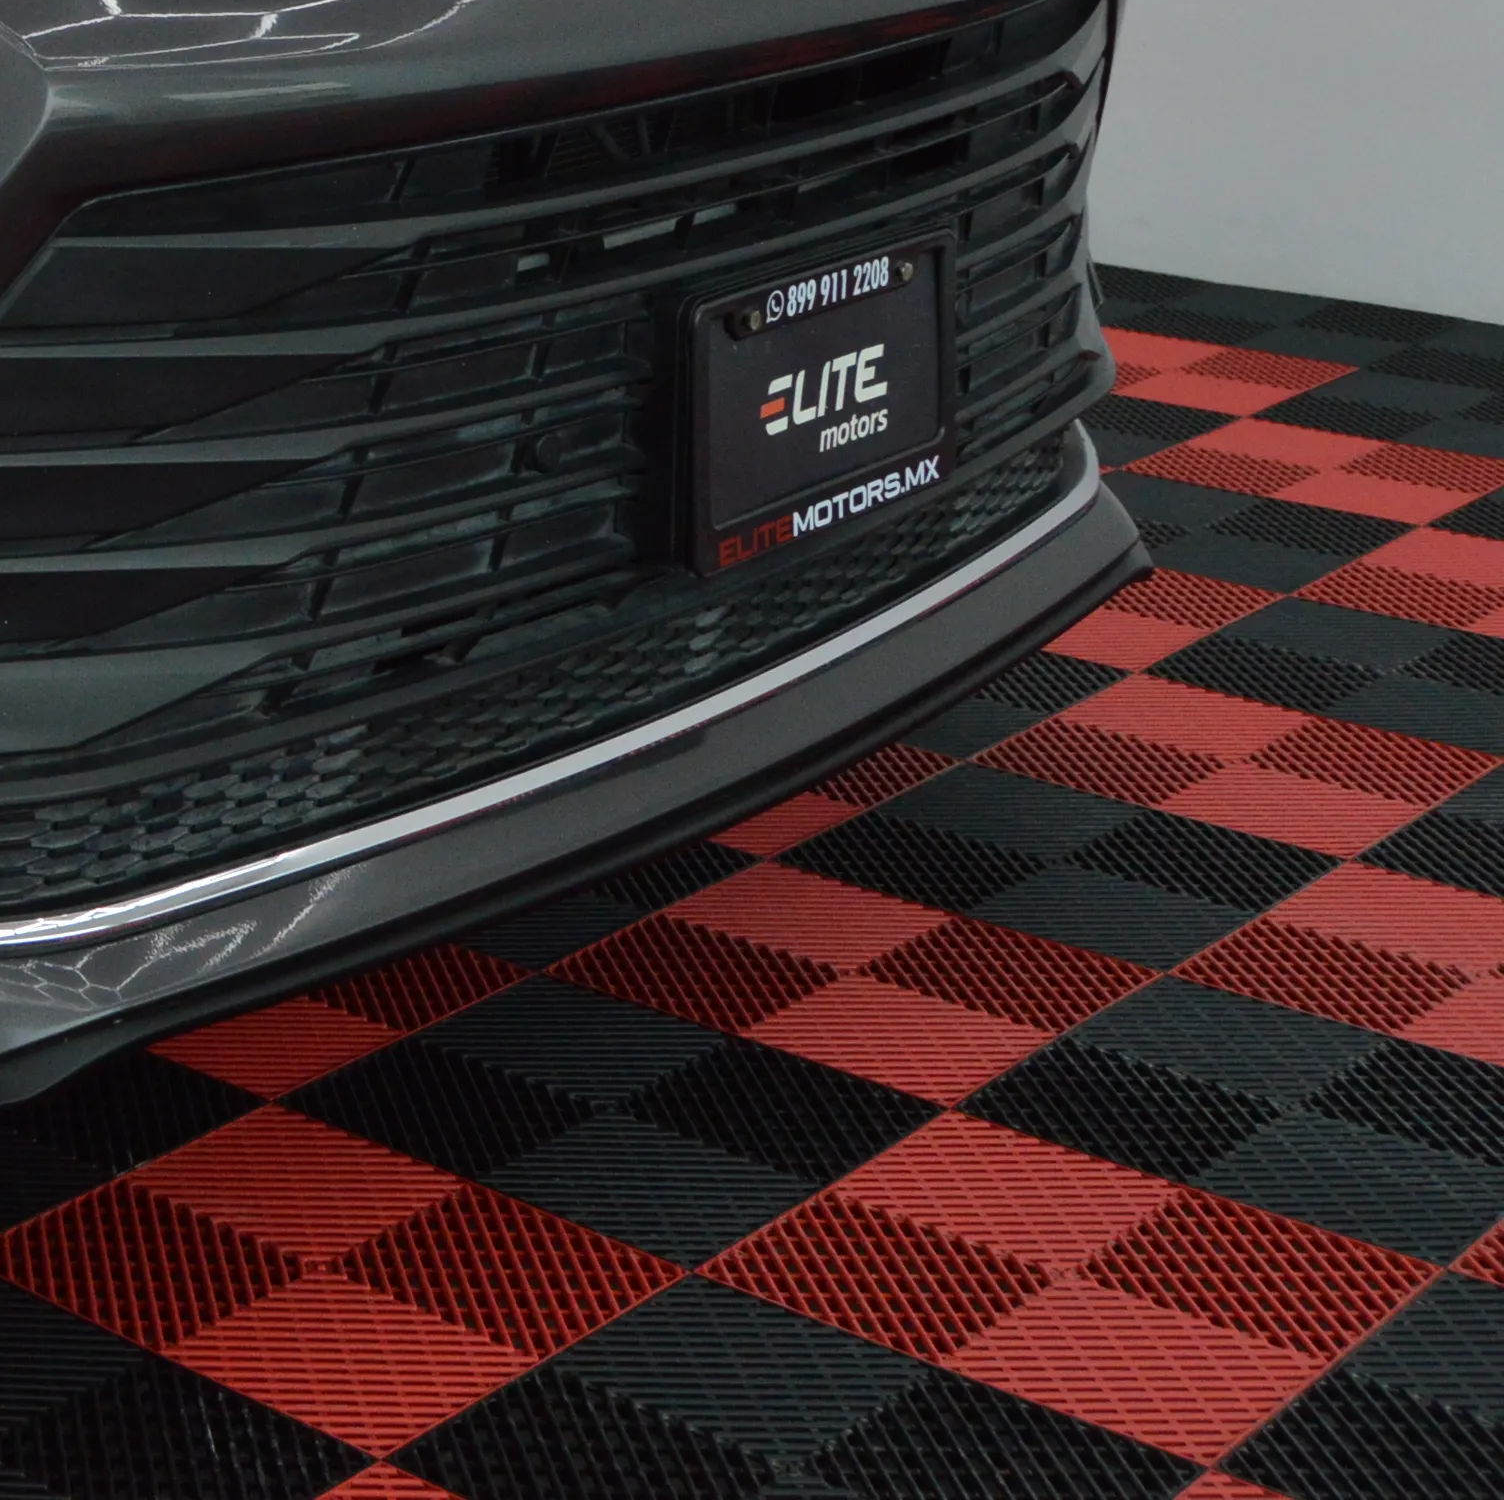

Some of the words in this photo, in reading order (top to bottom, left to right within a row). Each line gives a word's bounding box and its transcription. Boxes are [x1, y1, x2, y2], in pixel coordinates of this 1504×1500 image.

[786, 278, 817, 317] 899
[821, 268, 848, 307] 911
[852, 255, 890, 297] 2208
[760, 343, 889, 436] ELITE
[819, 408, 889, 453] motors
